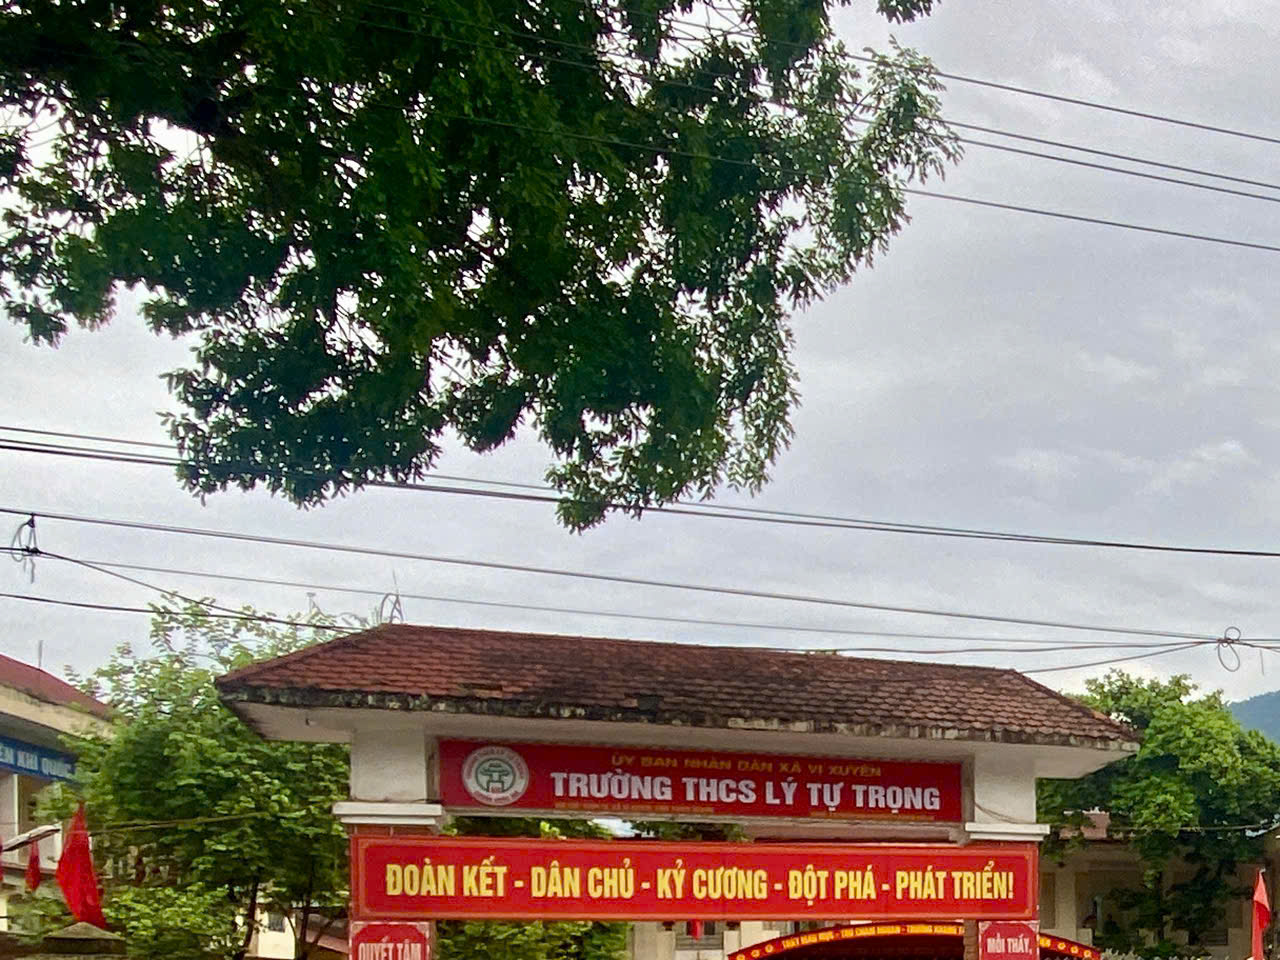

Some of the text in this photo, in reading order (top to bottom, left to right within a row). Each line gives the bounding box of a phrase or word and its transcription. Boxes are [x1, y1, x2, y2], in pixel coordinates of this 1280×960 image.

[641, 757, 678, 768] BAN
[684, 757, 731, 771] NHÂN
[550, 768, 672, 801] TRƯỜNG
[682, 777, 757, 803] THCS
[765, 777, 798, 805] LÝ
[807, 782, 844, 811] TỰ
[852, 784, 940, 813] TRỌNG
[386, 858, 455, 896] ĐOÀN
[463, 856, 507, 897] KẾT
[531, 860, 580, 898] DÂN
[588, 858, 634, 898] CHỦ
[657, 859, 686, 899] KỶ
[693, 866, 768, 900] CƯƠNG
[788, 864, 829, 906] ĐỘT
[834, 865, 876, 899] PHÁ
[896, 865, 946, 899] PHÁT
[951, 860, 1014, 899] TRIỂN!
